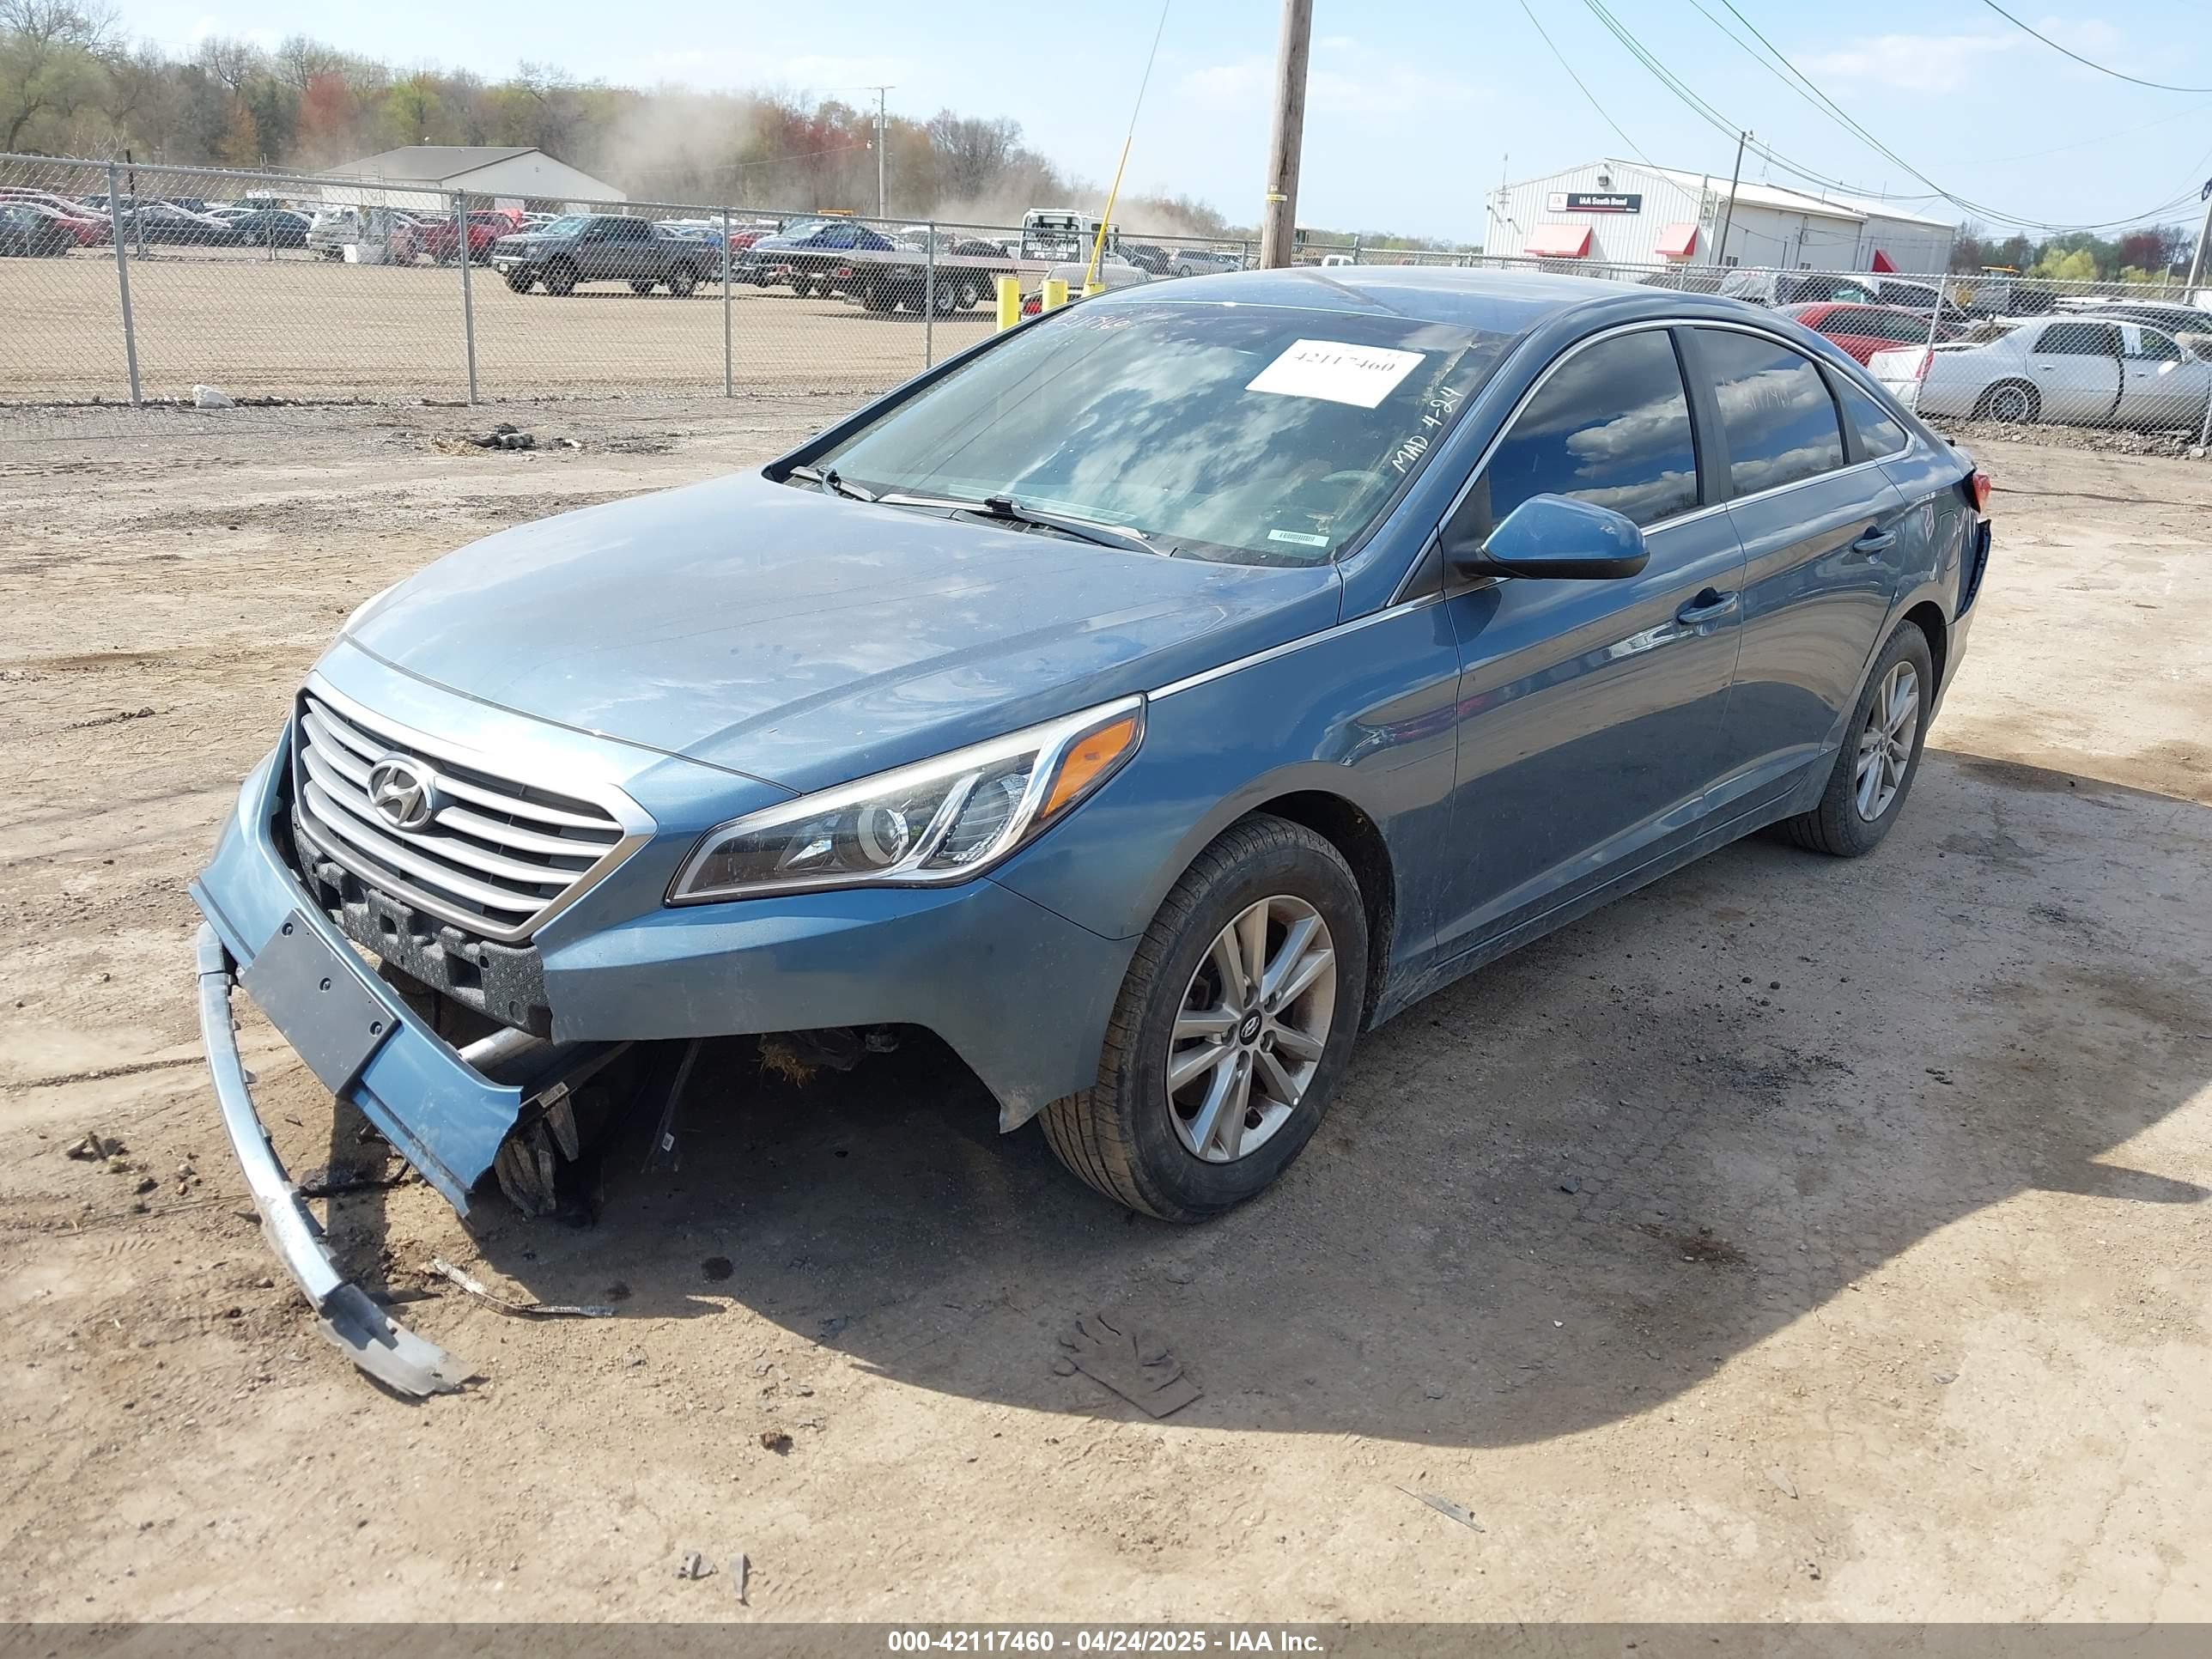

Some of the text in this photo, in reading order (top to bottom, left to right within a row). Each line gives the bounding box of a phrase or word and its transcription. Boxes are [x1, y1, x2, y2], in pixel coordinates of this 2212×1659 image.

[1592, 196, 1610, 205] South
[1611, 197, 1628, 206] Bend
[1391, 386, 1464, 474] MAD 4-24
